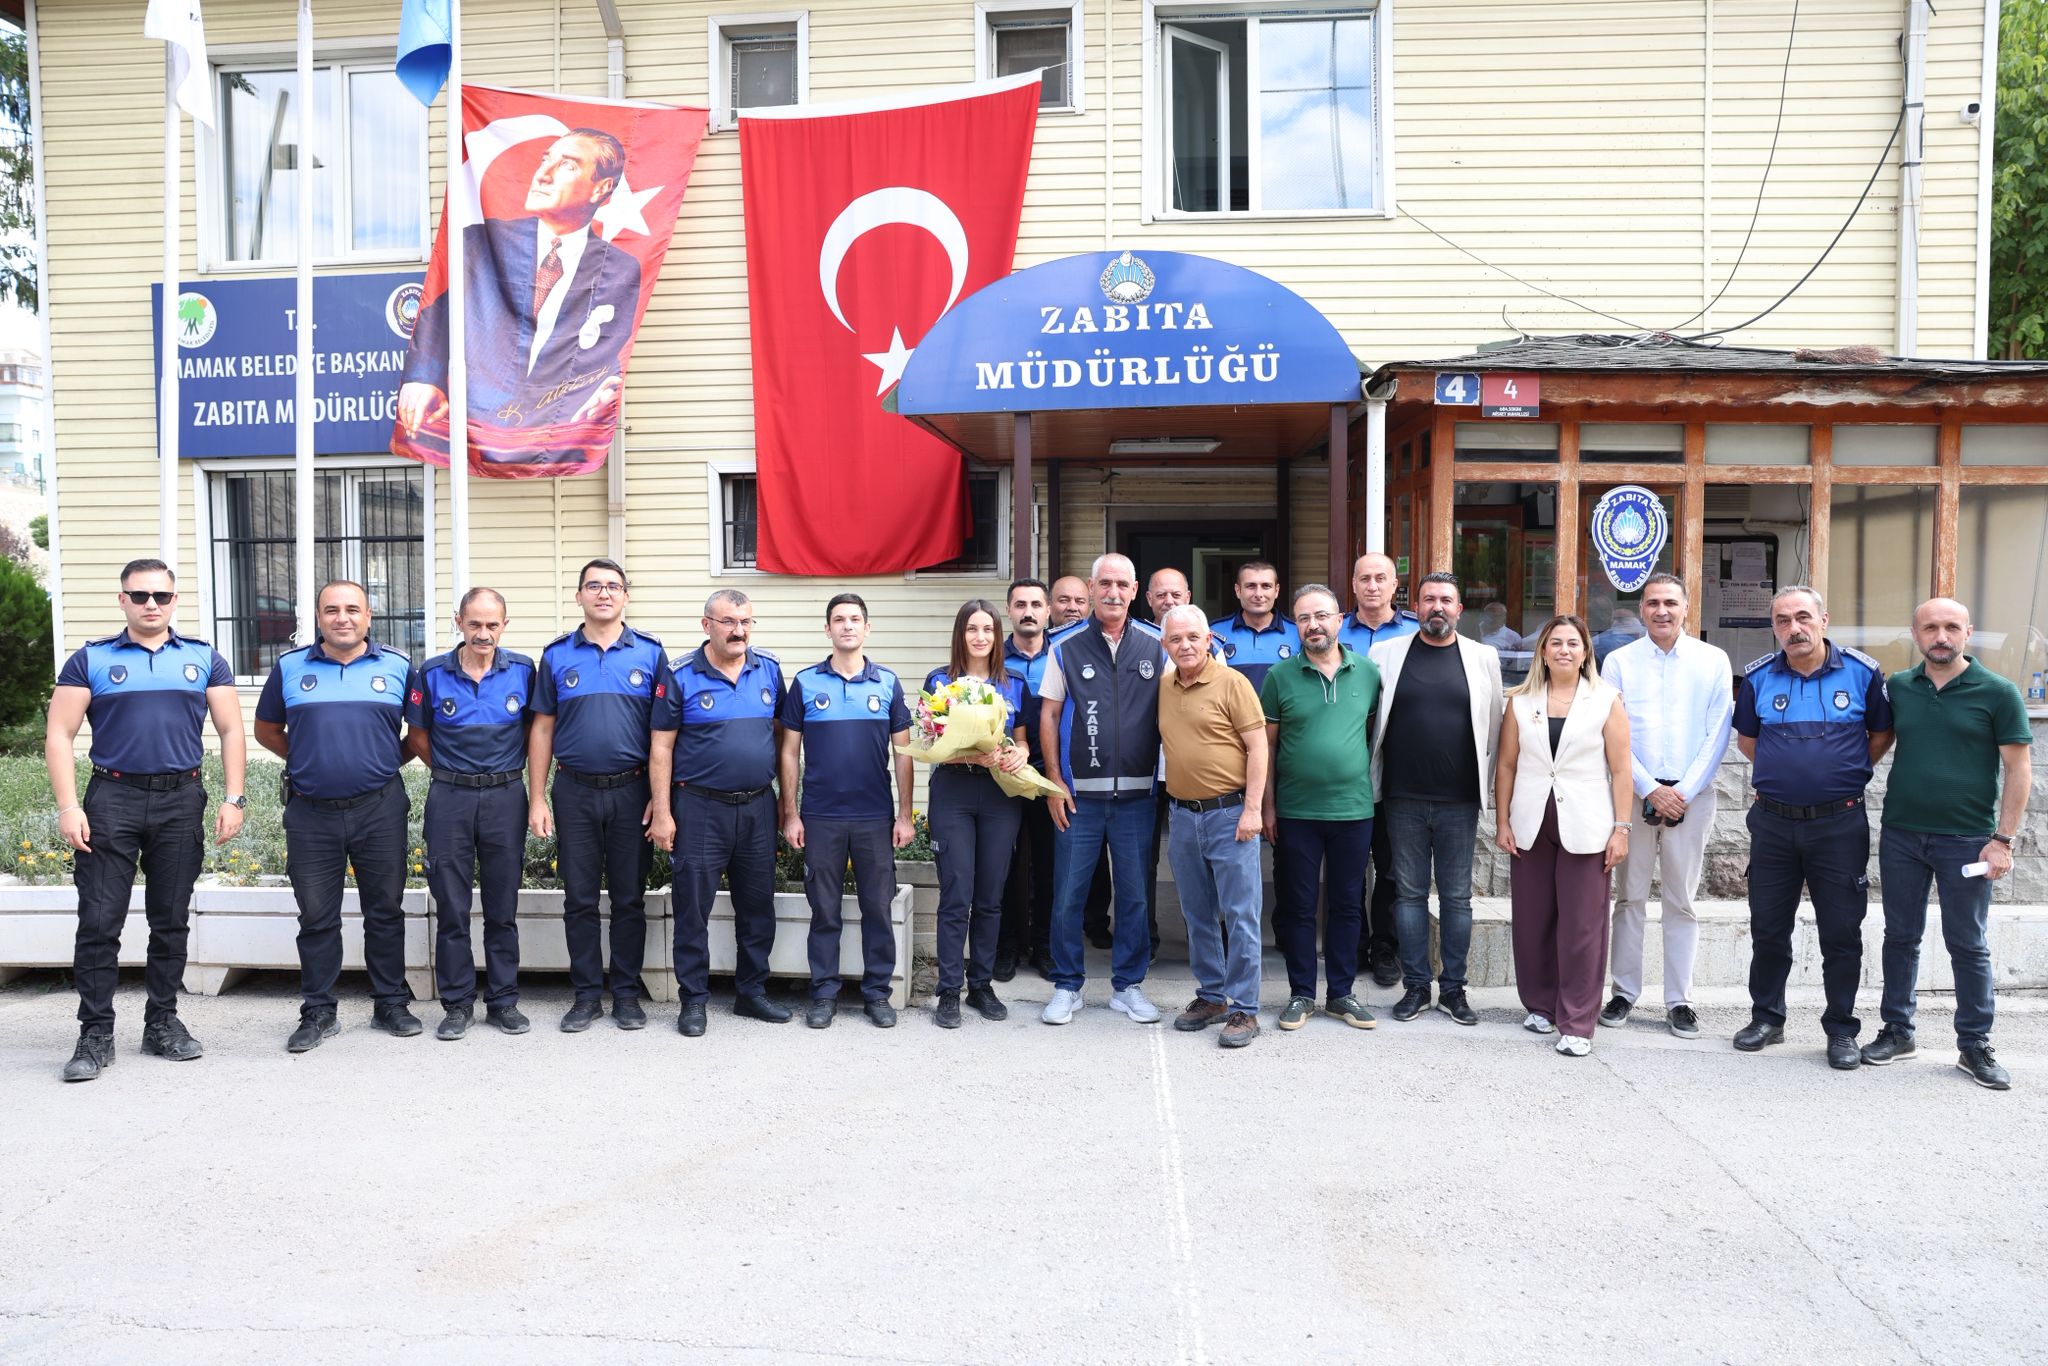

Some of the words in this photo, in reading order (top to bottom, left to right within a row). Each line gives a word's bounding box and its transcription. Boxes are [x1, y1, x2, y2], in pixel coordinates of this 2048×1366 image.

[285, 309, 317, 330] T..
[1040, 302, 1213, 334] ZABITA
[241, 352, 326, 377] BELEDE
[331, 350, 405, 378] BAŞKAN
[975, 343, 1281, 390] MÜDÜRLÜĞÜ
[1445, 375, 1466, 403] 4
[1503, 379, 1518, 400] 4
[193, 399, 270, 426] ZABITA
[275, 390, 398, 424] MDÜRLÜĞ
[1610, 493, 1649, 508] ZABITA
[1609, 561, 1647, 570] MAMAK
[1610, 569, 1649, 589] BELEDİYESİ
[1086, 700, 1101, 768] ZABITA
